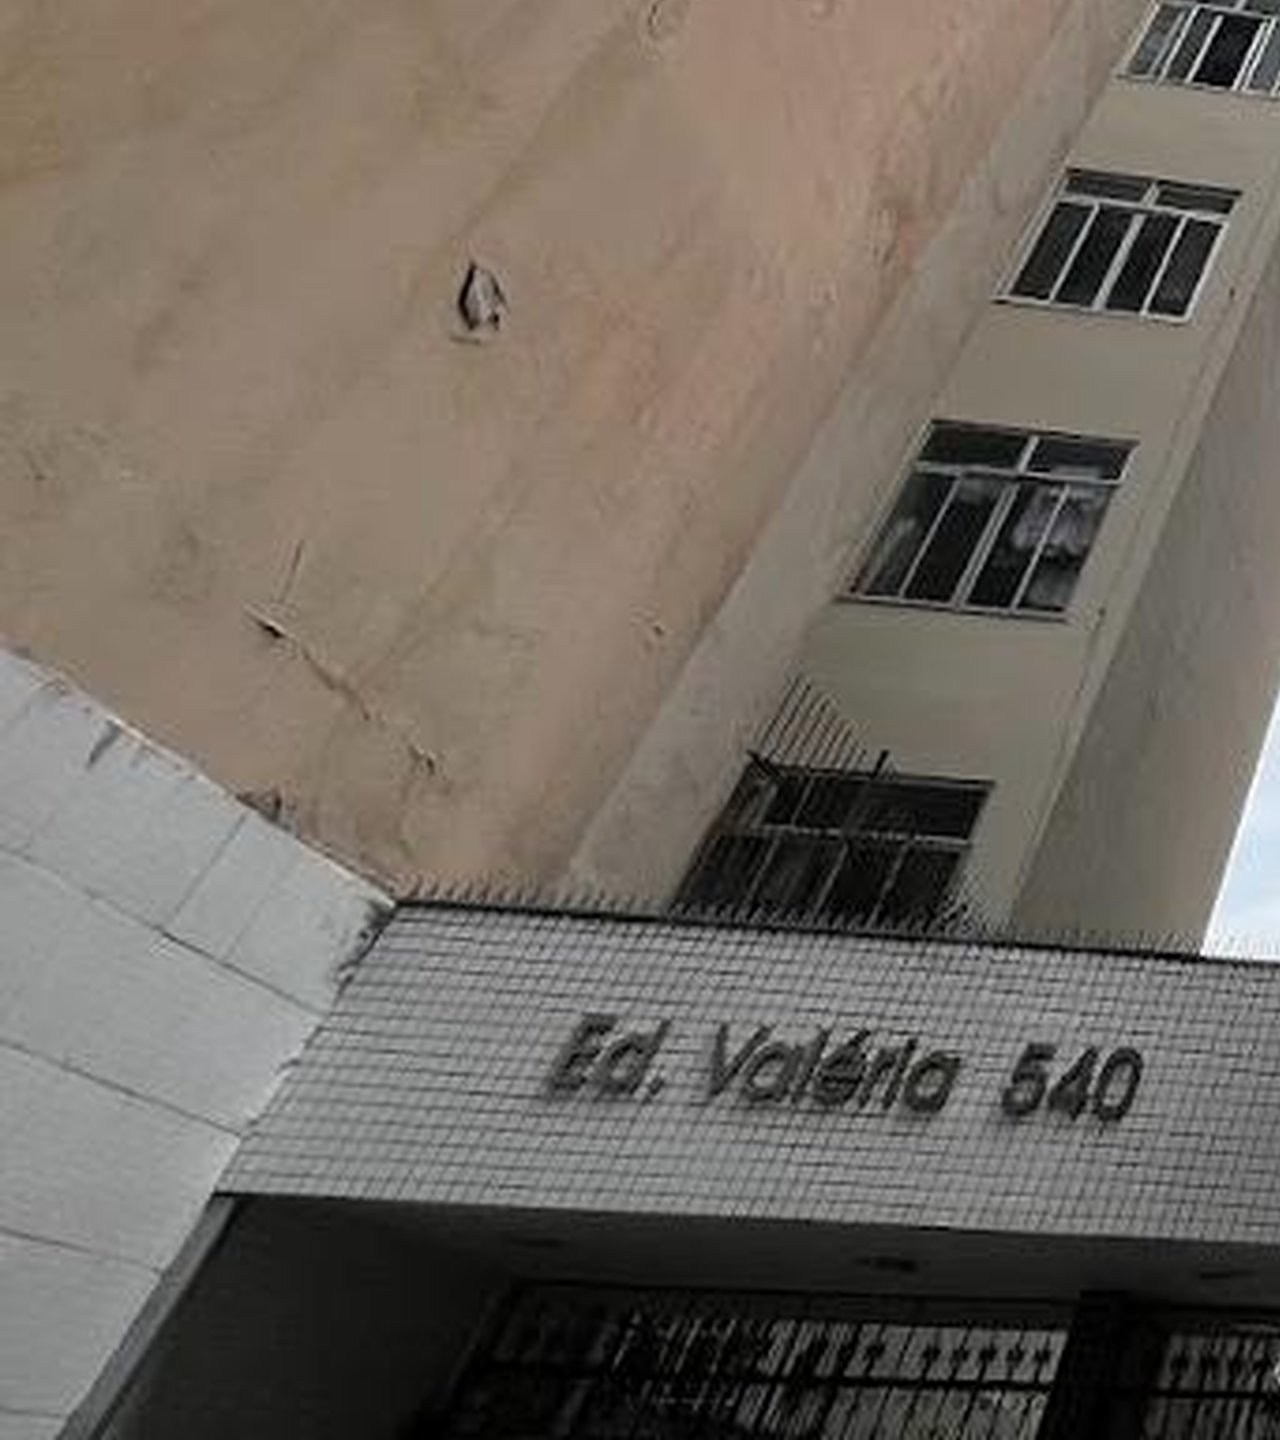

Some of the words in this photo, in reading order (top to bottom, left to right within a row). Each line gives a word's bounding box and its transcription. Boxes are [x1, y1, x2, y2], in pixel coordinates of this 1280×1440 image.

[549, 1012, 670, 1101] Ed.
[711, 1020, 962, 1116] Valéria
[1002, 1042, 1142, 1122] 540
